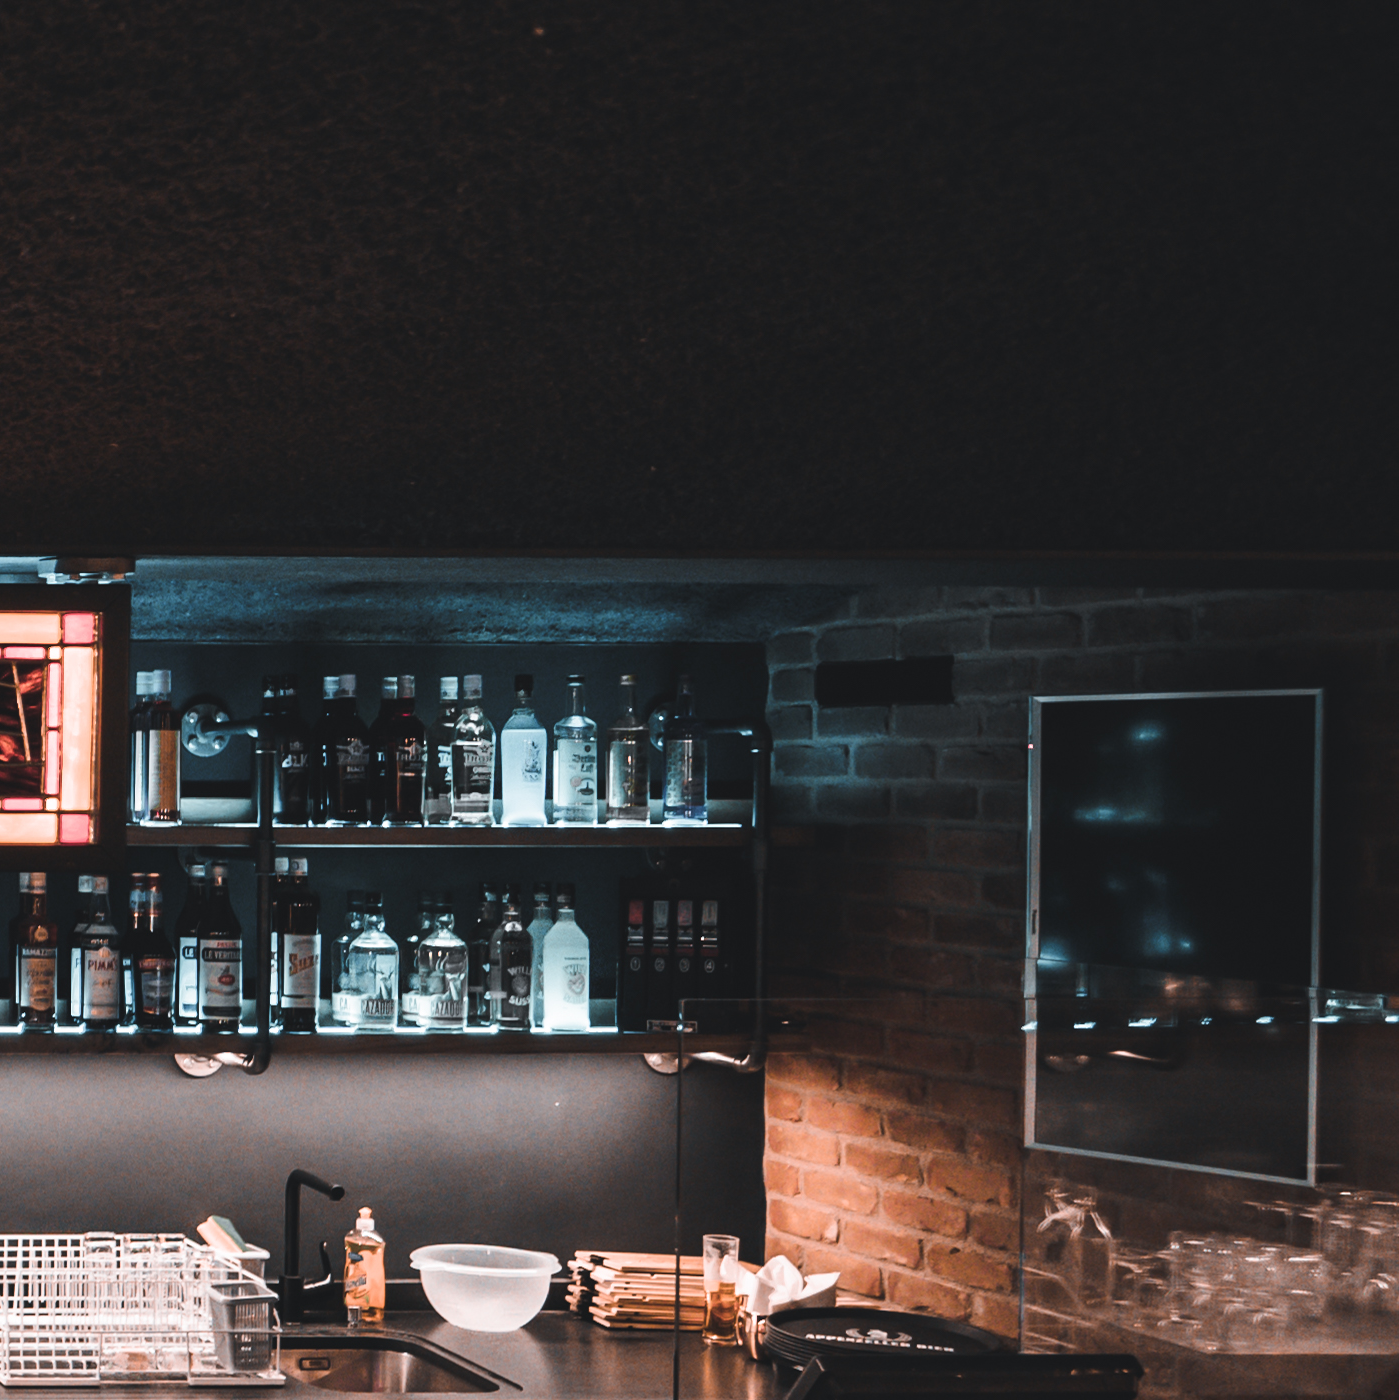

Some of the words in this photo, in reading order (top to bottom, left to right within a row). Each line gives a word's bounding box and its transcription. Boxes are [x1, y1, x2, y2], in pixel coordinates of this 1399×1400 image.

[88, 958, 118, 971] PIMM'S
[805, 1333, 911, 1348] APPENZELLER
[916, 1343, 955, 1353] BIER
